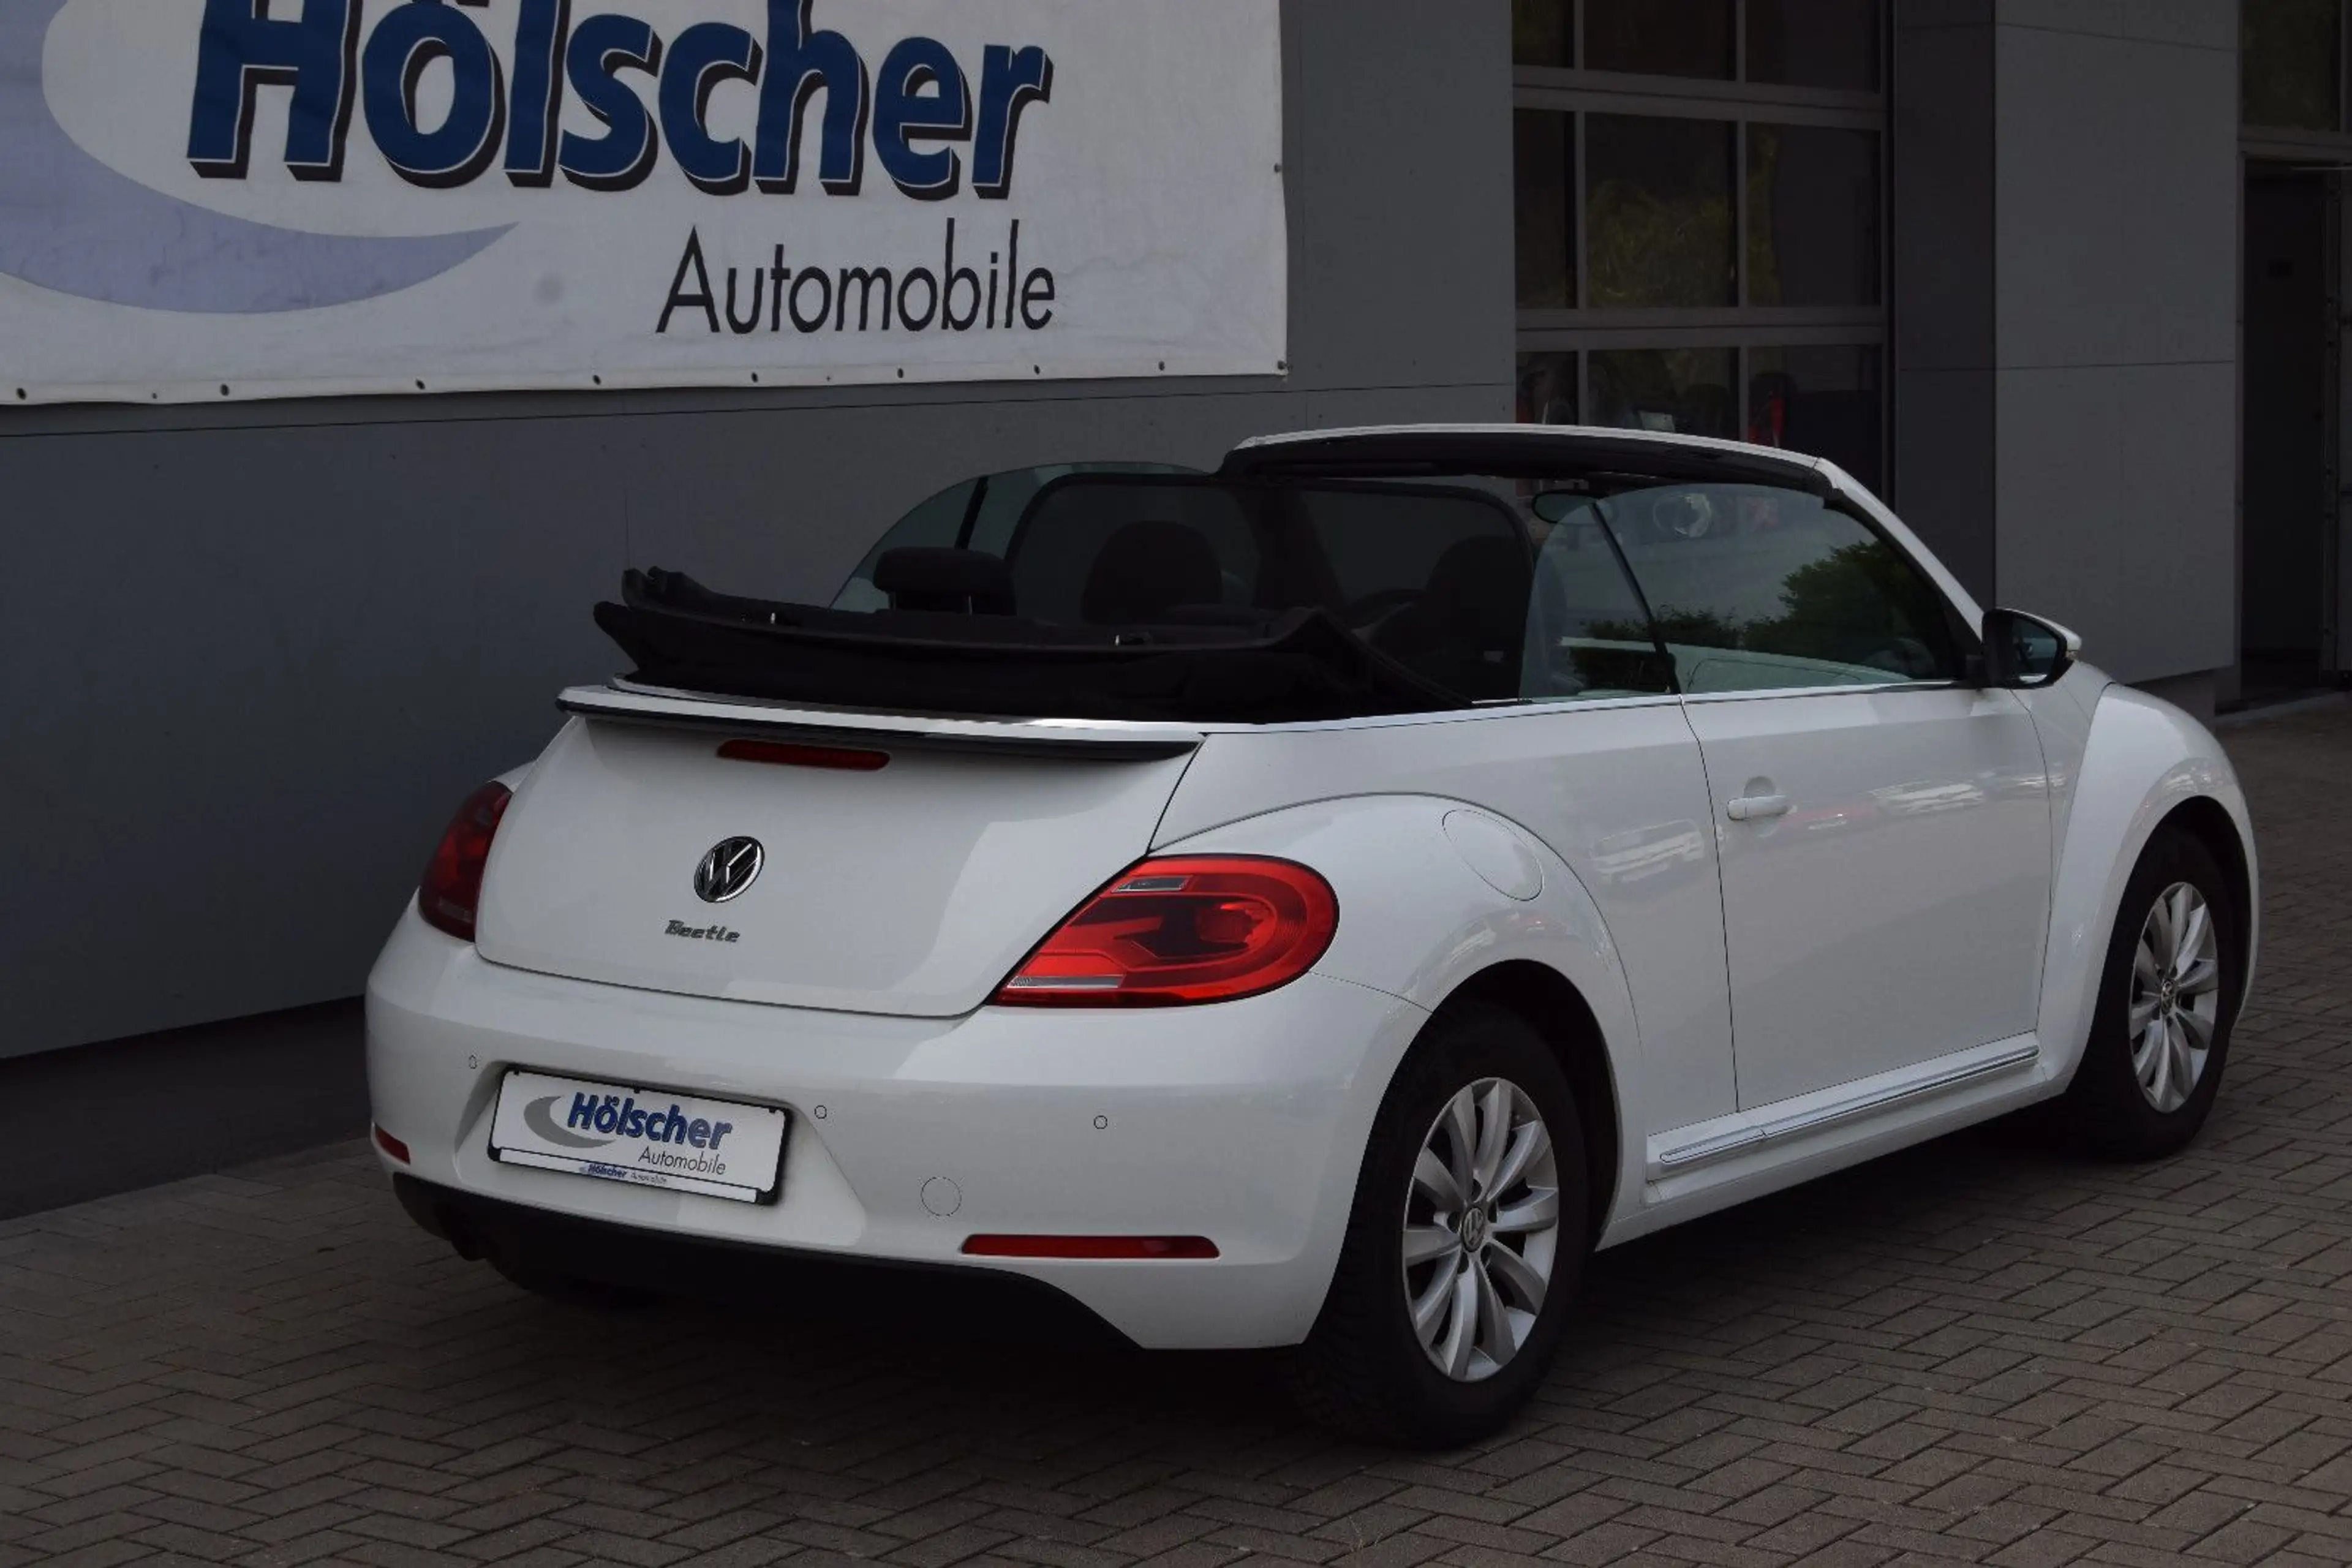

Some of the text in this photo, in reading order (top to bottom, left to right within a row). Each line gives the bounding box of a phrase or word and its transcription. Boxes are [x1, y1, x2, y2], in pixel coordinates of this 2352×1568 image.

[655, 217, 1056, 335] Automobile
[664, 919, 741, 943] Beetle
[567, 1091, 733, 1150] Hölscher
[638, 1146, 727, 1176] Automobile
